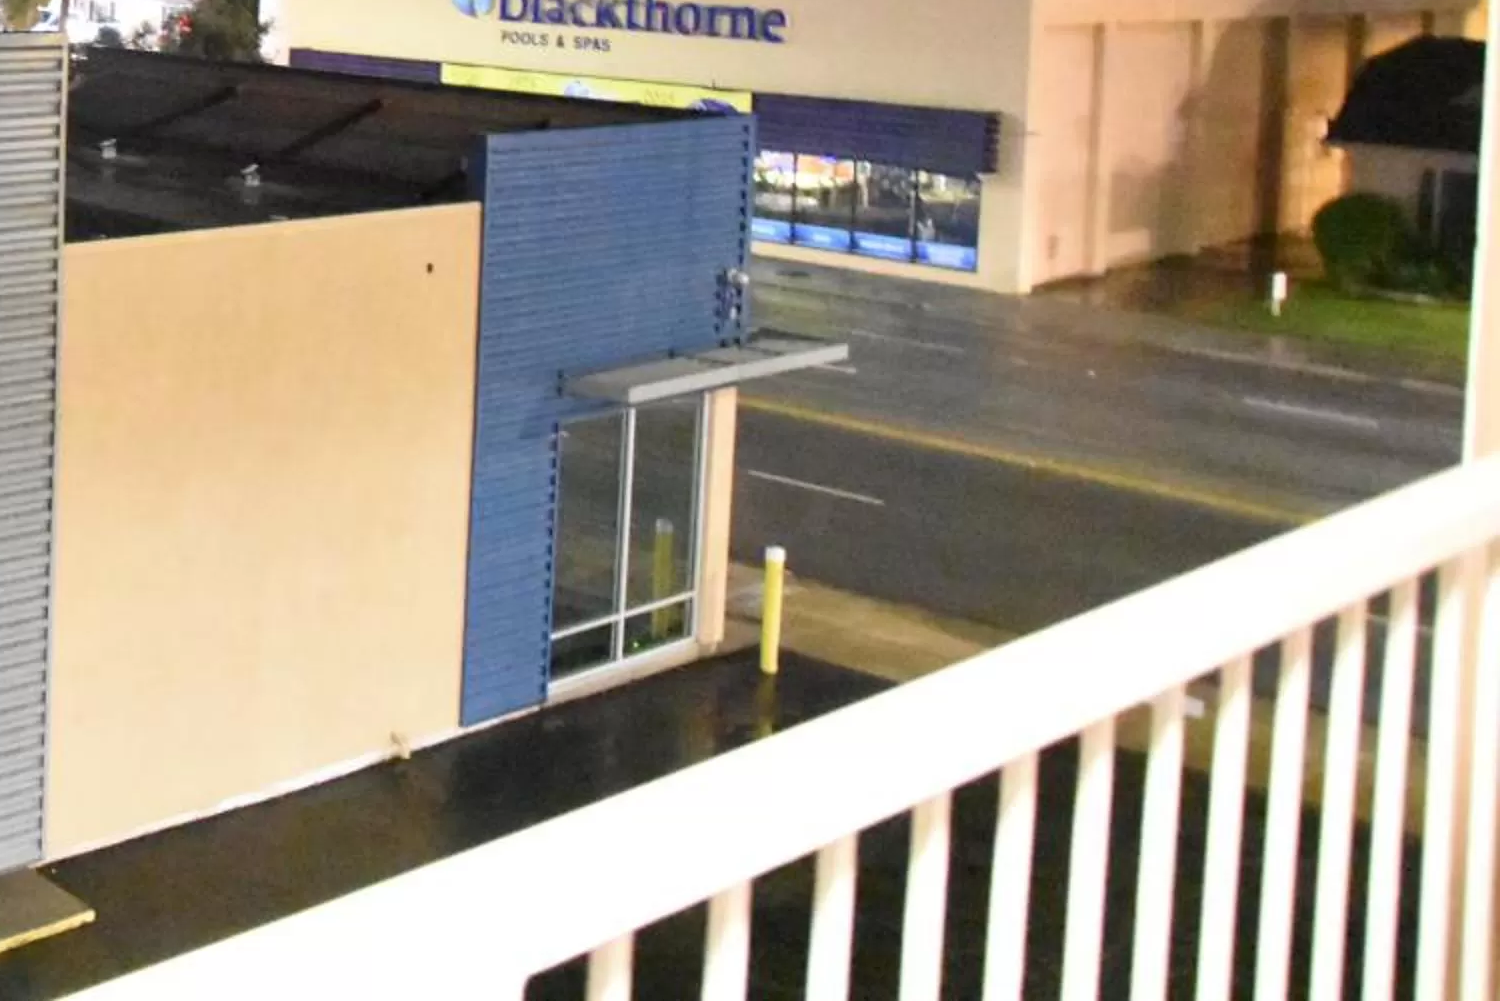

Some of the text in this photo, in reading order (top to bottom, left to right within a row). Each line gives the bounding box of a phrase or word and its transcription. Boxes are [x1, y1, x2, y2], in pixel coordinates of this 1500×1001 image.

[501, 31, 611, 52] POOLS & SPAS
